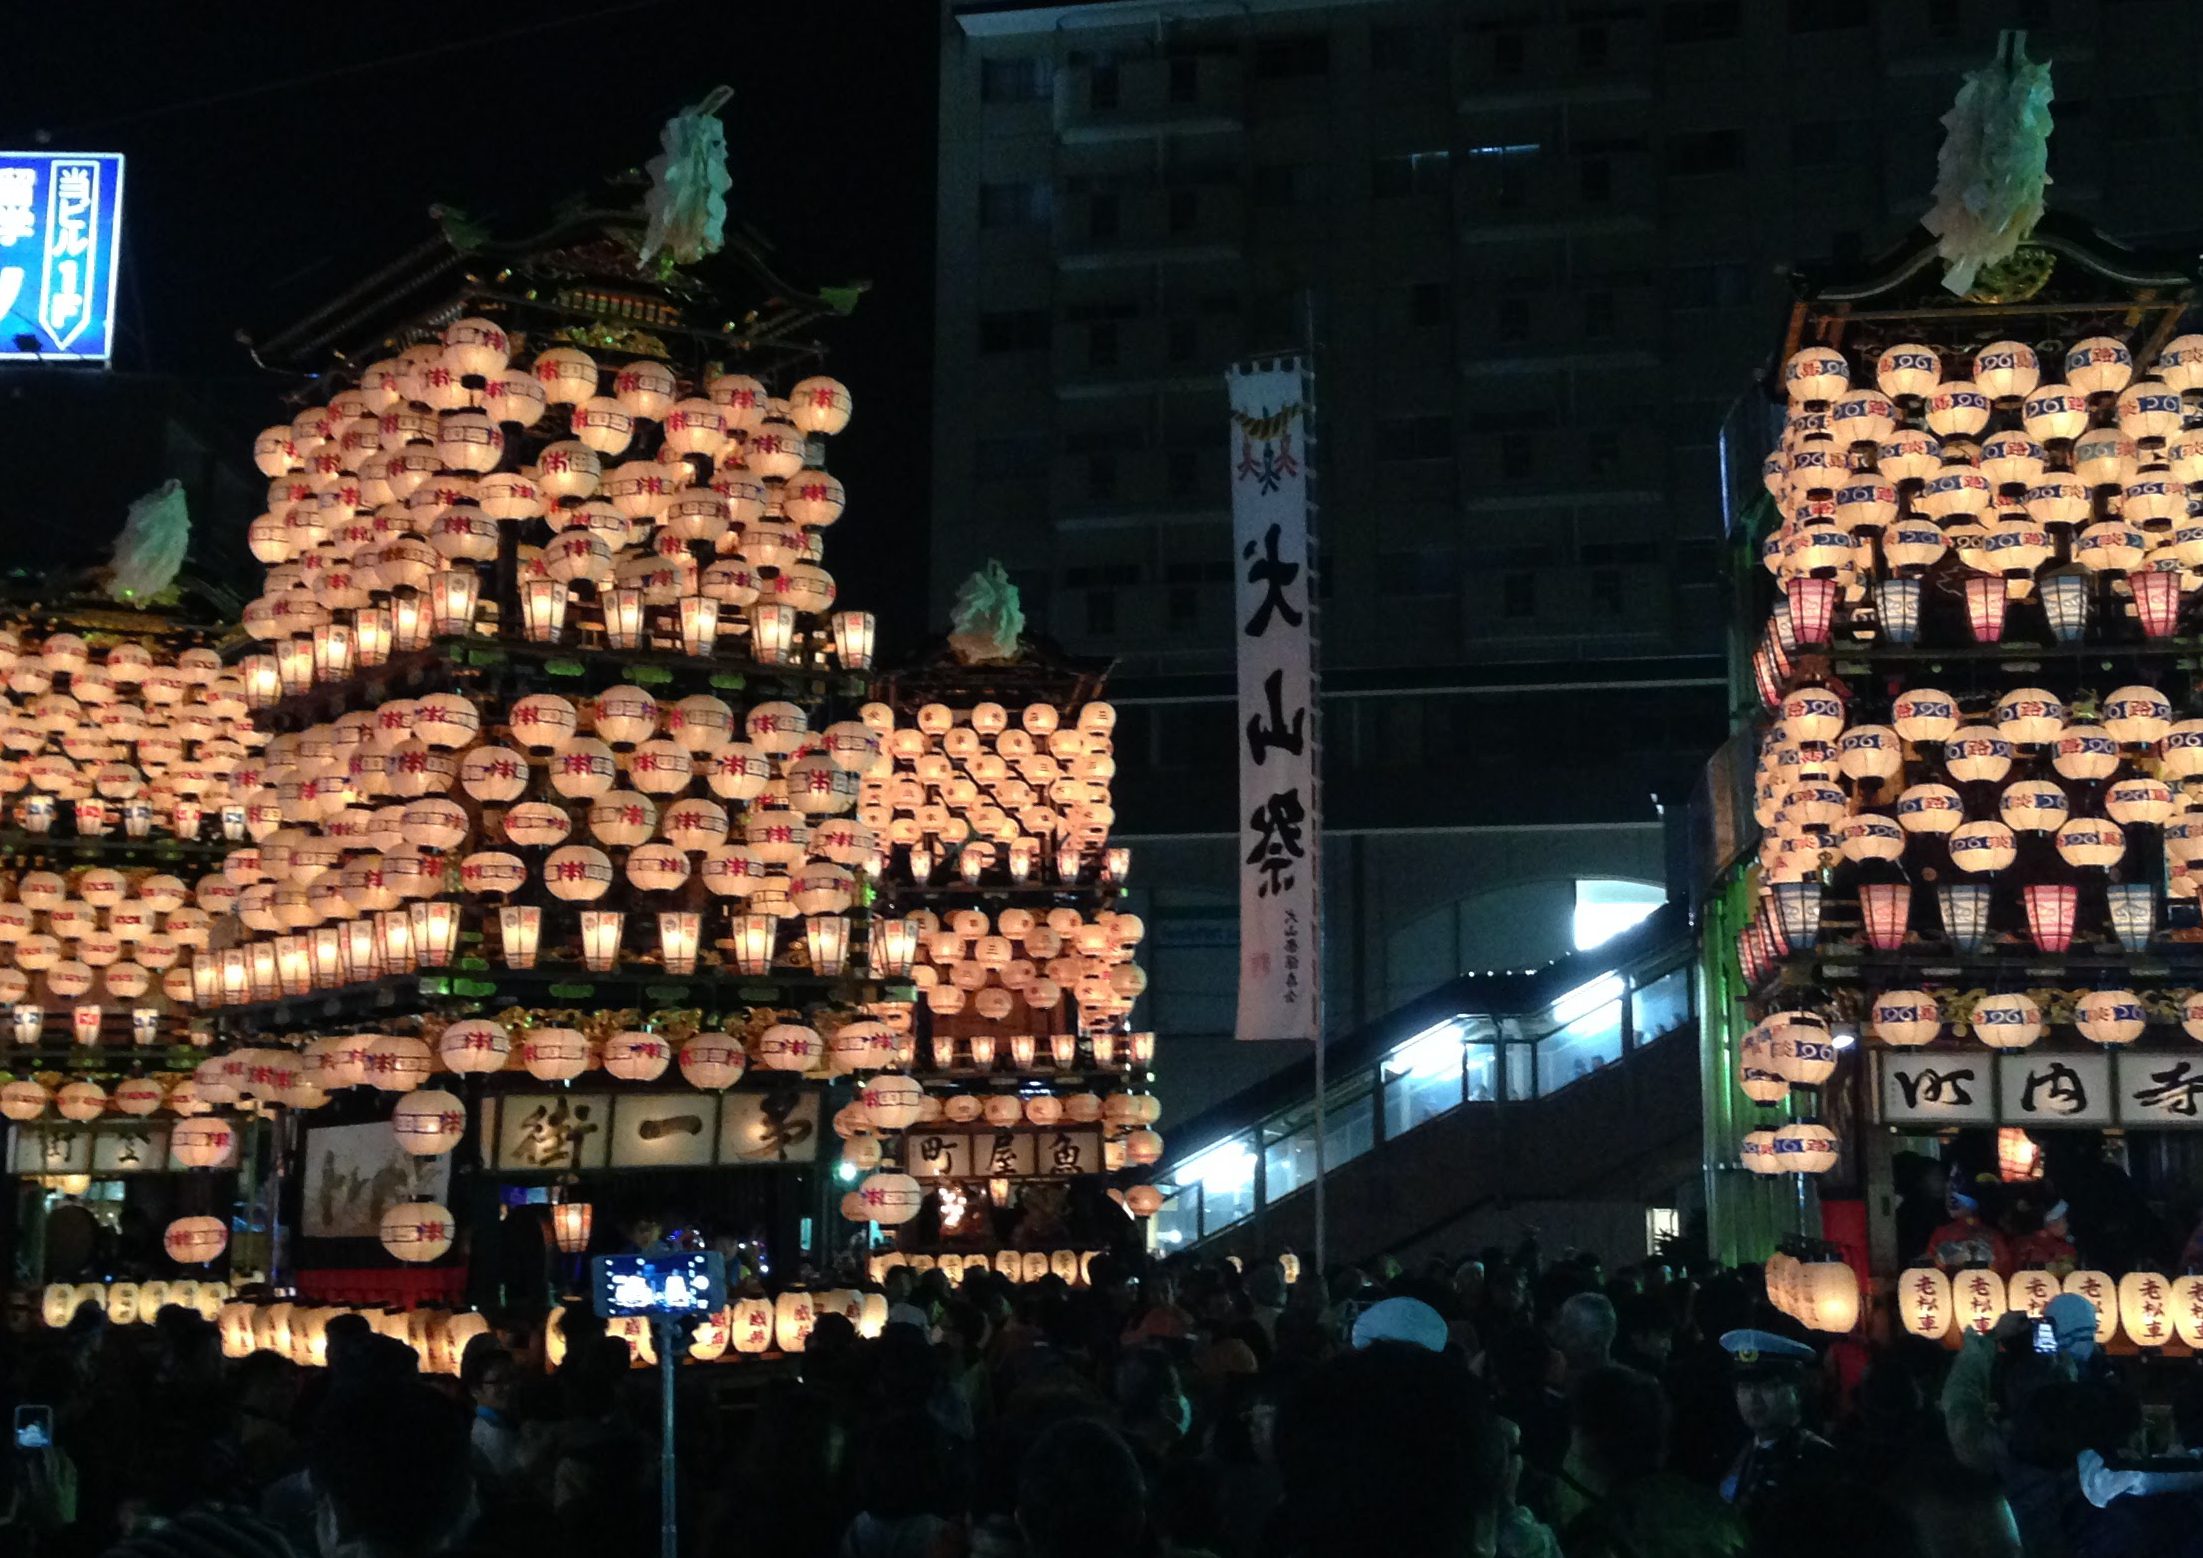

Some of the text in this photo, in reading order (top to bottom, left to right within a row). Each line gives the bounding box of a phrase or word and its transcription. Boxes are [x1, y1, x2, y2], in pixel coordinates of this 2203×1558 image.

[51, 166, 91, 329] 当ビル1F
[1244, 523, 1305, 898] 犬山祭
[1914, 1274, 1939, 1331] 老松車
[1968, 1276, 1993, 1333] 老松車
[2138, 1277, 2164, 1338] 老松車
